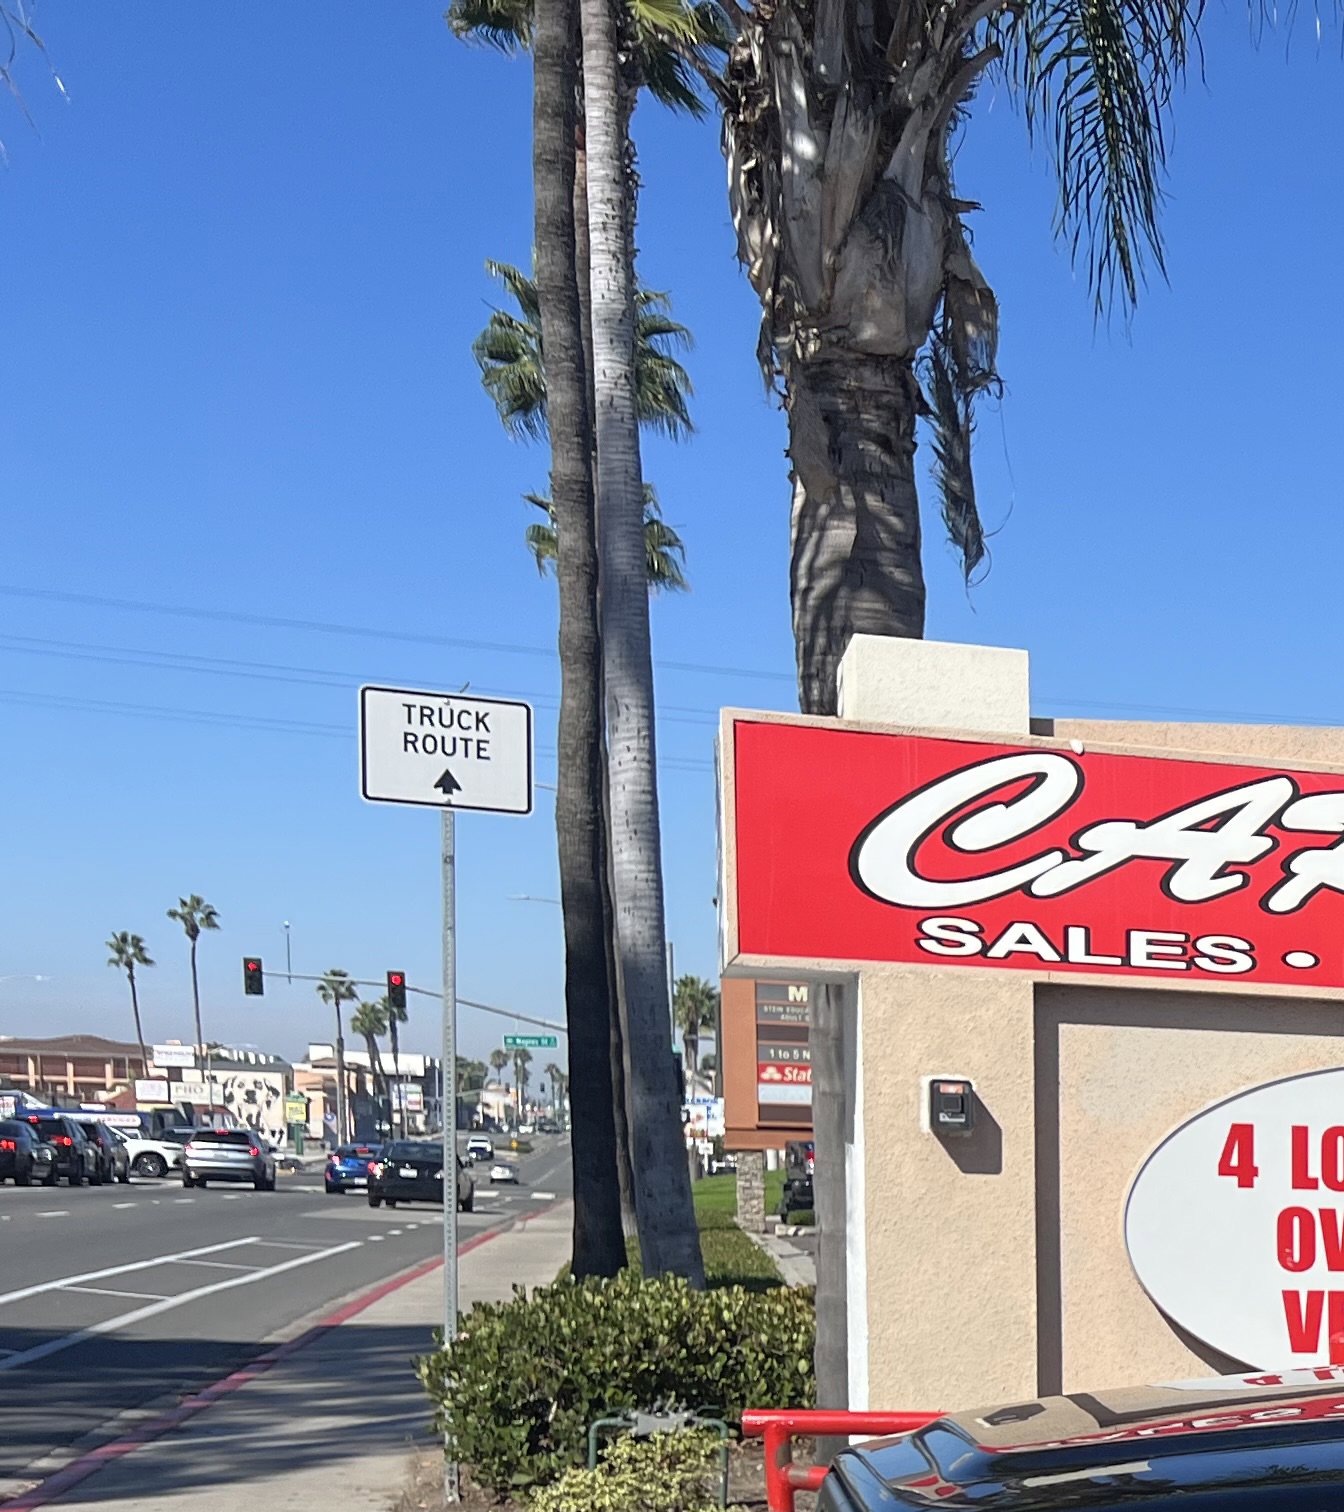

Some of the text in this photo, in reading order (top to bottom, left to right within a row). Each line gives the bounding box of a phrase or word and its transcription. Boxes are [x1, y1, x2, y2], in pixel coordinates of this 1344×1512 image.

[402, 703, 491, 733] TRUCK
[403, 731, 491, 761] ROUTE
[917, 916, 1256, 973] SALES
[1218, 1123, 1259, 1189] 4
